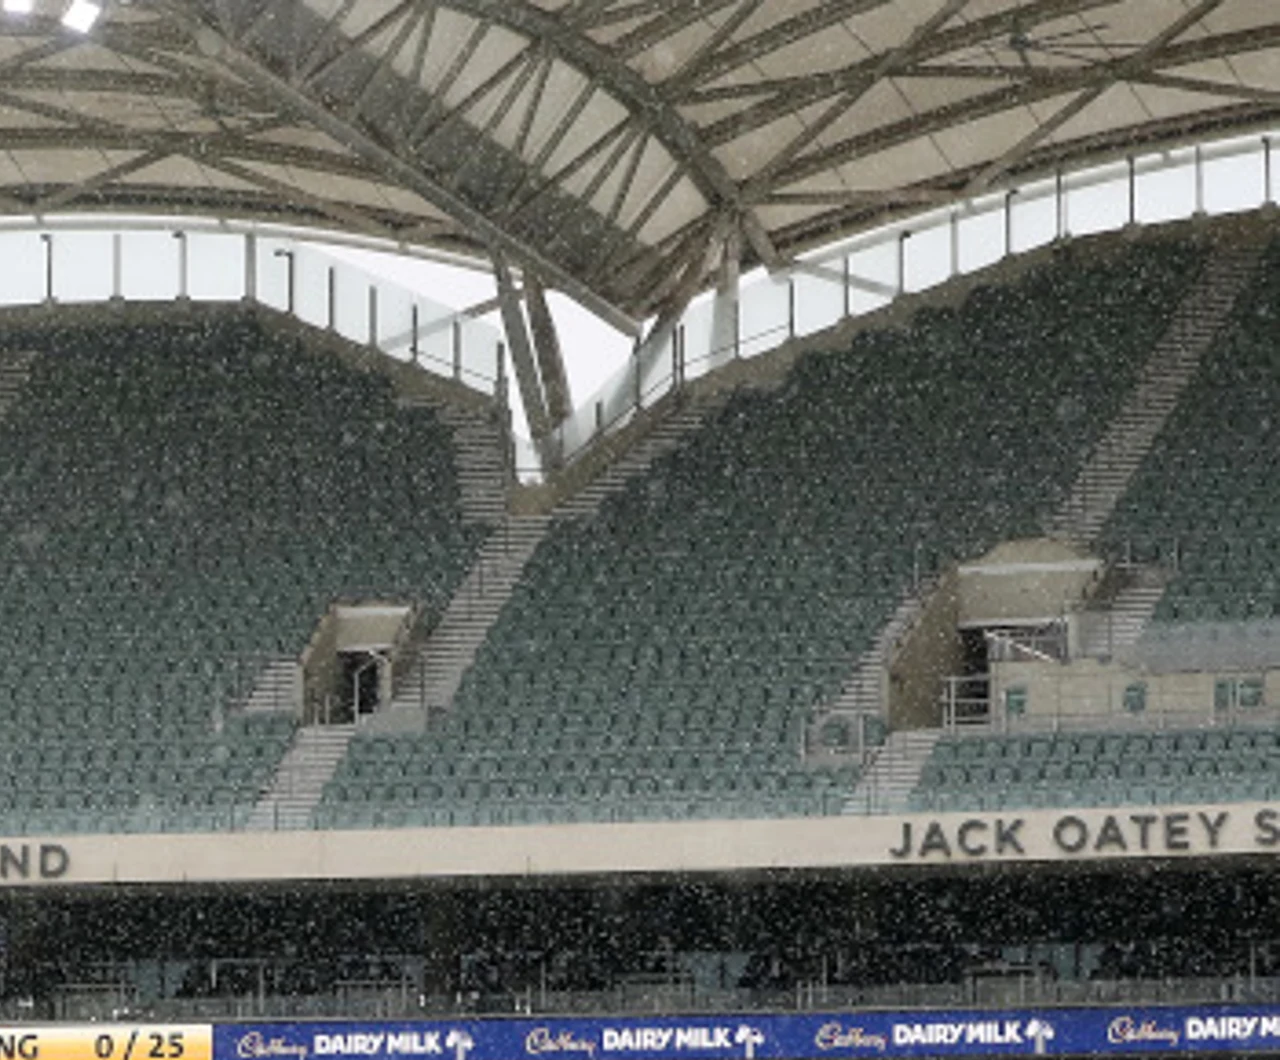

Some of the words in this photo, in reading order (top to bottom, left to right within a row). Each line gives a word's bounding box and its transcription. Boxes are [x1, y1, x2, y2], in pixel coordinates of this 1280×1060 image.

[889, 818, 1026, 859] JACK
[1052, 811, 1229, 854] OATEY
[313, 1033, 384, 1055] DAIRY
[386, 1031, 443, 1054] MILK
[526, 1027, 596, 1057] Cadbury
[602, 1027, 674, 1051] DAIRY
[675, 1026, 732, 1050] MILK
[815, 1021, 888, 1050] Cadbury
[892, 1022, 964, 1045] DAIRY
[965, 1020, 1024, 1044] MILK
[1108, 1015, 1180, 1046] Cadbury
[1186, 1016, 1258, 1039] DAIRY
[94, 1033, 115, 1059] 0
[148, 1033, 185, 1059] 25
